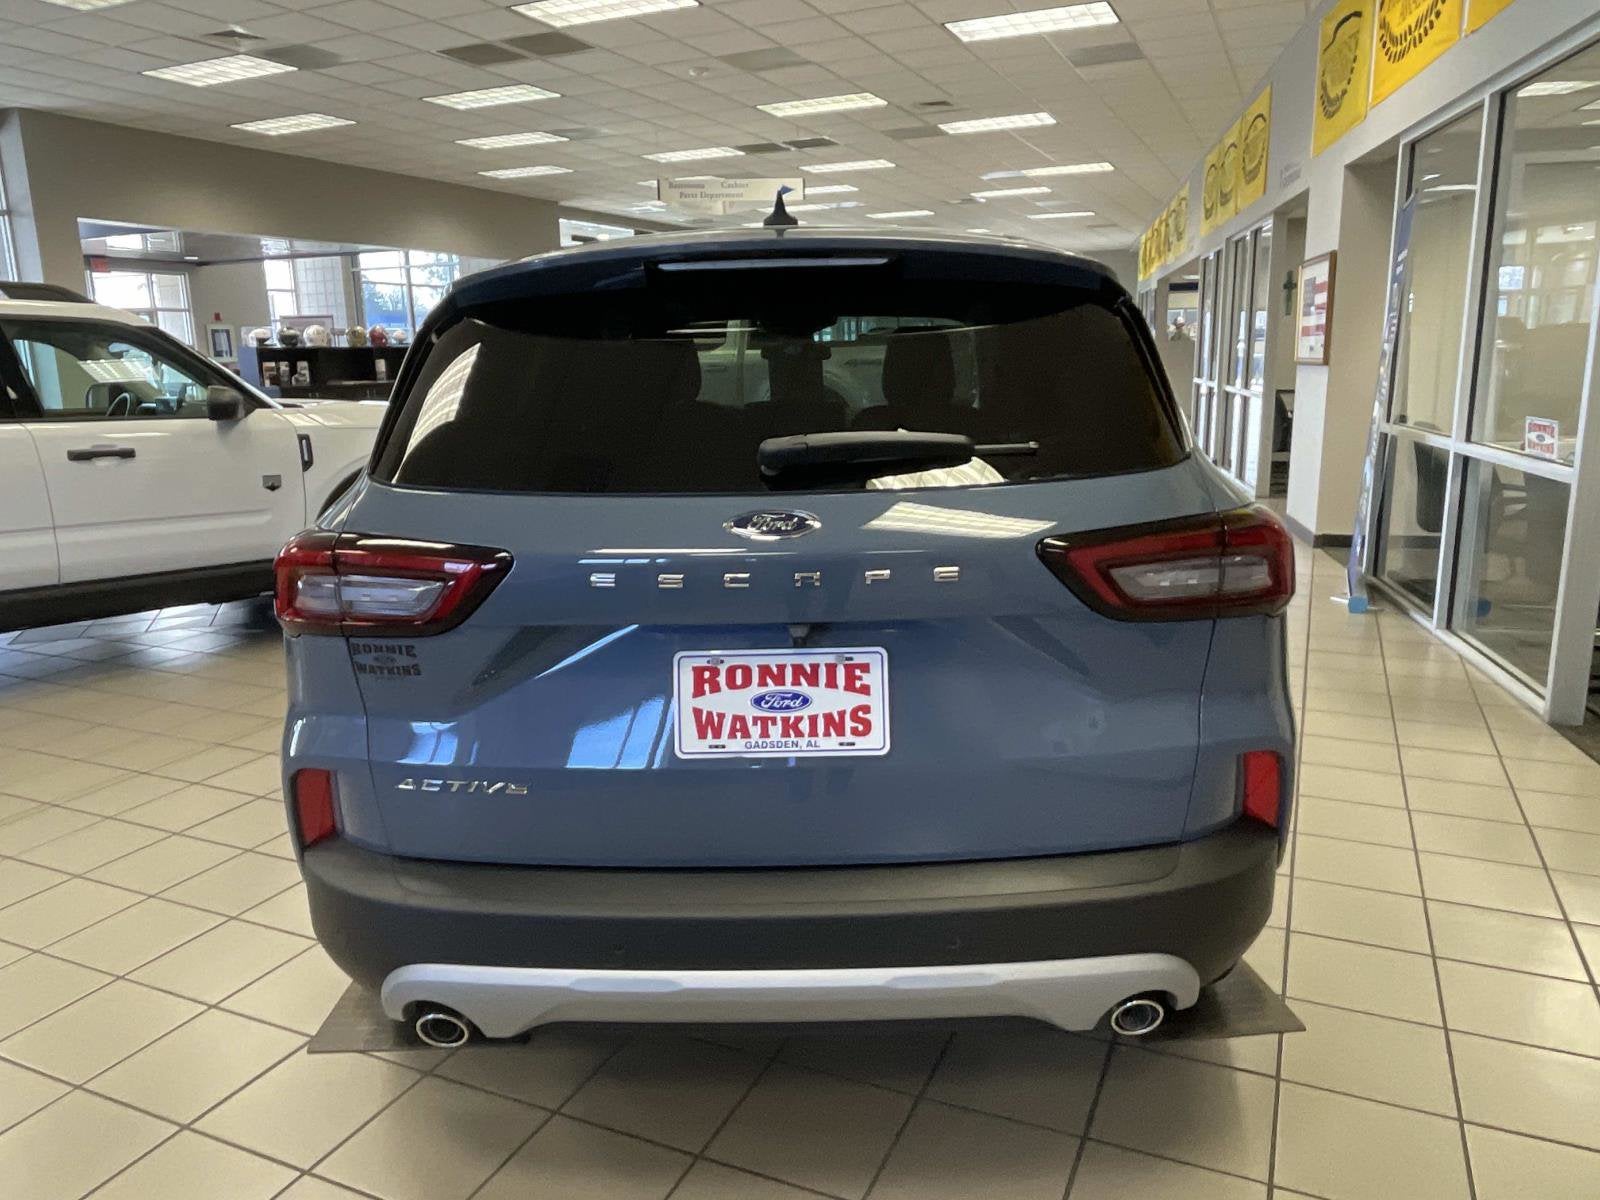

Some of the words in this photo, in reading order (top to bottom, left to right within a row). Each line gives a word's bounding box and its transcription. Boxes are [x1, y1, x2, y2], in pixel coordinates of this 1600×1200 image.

[700, 191, 743, 200] Department
[747, 513, 798, 532] Ford
[589, 565, 961, 587] ESCAPE
[351, 643, 417, 657] RONNIE
[355, 661, 422, 676] WATKINS
[691, 662, 872, 698] RONNIE
[760, 693, 804, 708] Ford
[691, 703, 873, 740] WATKINS
[744, 740, 802, 750] GADSDEN,
[806, 740, 821, 748] AL
[396, 779, 528, 795] ACTIVE
